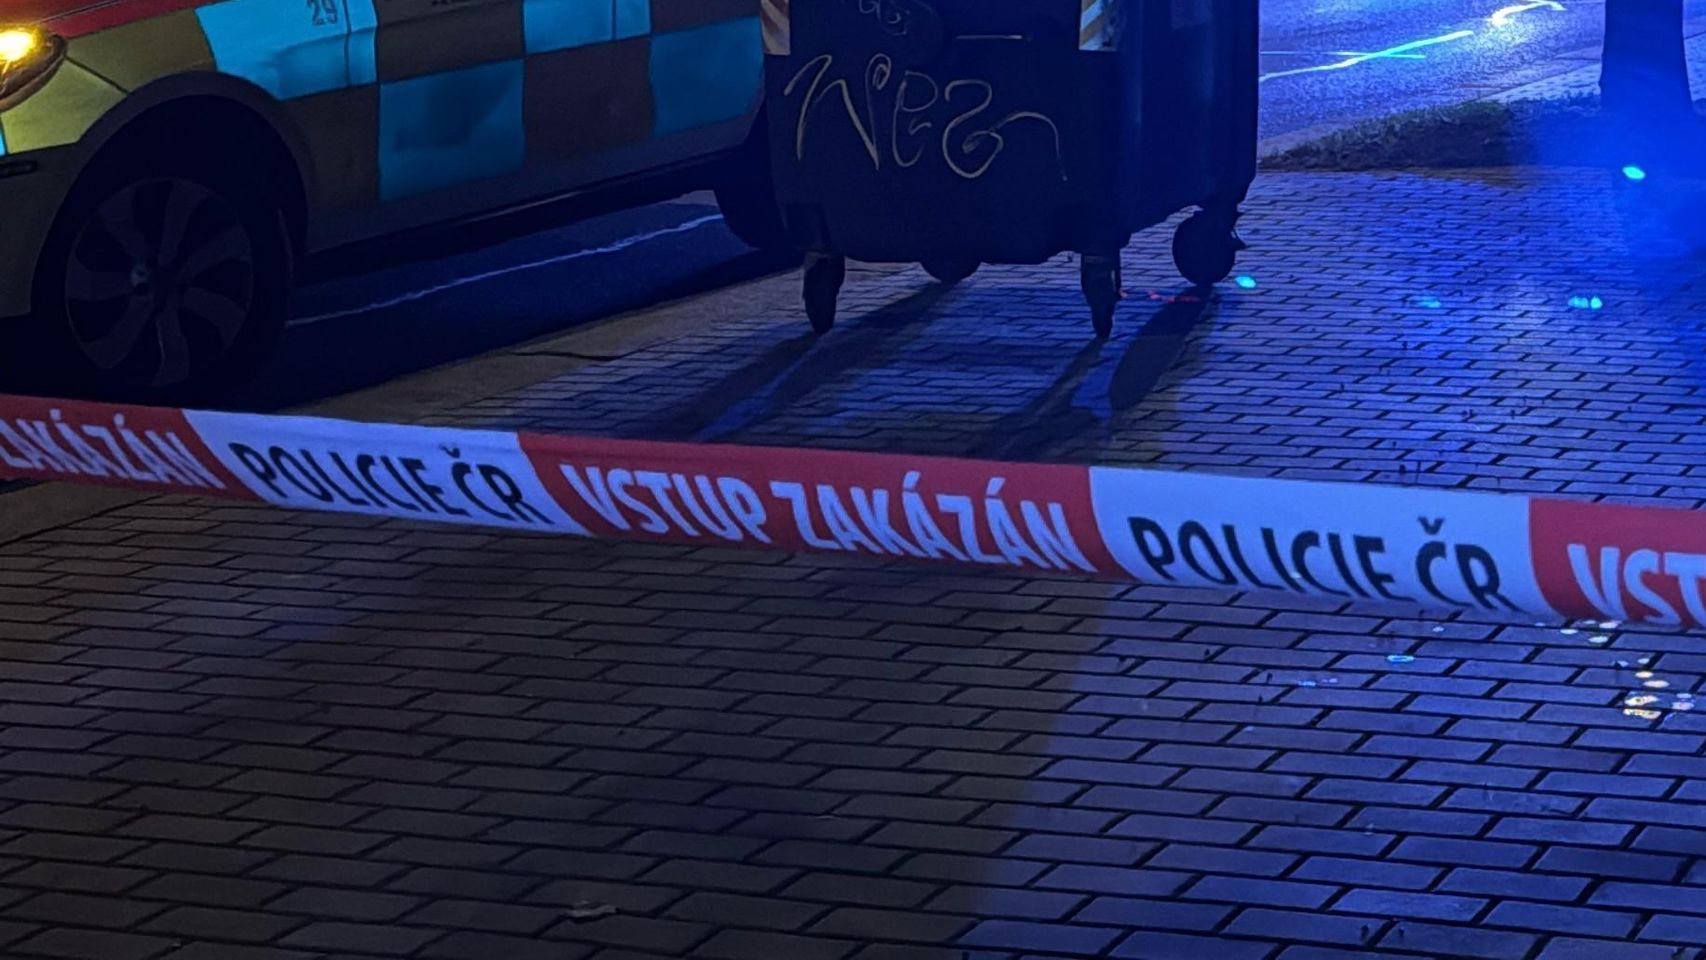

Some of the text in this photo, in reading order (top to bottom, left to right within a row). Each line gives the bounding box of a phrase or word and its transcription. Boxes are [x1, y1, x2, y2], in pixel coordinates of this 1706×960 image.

[228, 442, 475, 519] POLICIE
[443, 445, 557, 526] ČR
[560, 464, 772, 543] VSTUP
[771, 471, 1098, 573] ZAKÁZÁN
[1128, 516, 1414, 603] POLICIE
[1414, 515, 1524, 612] ČR
